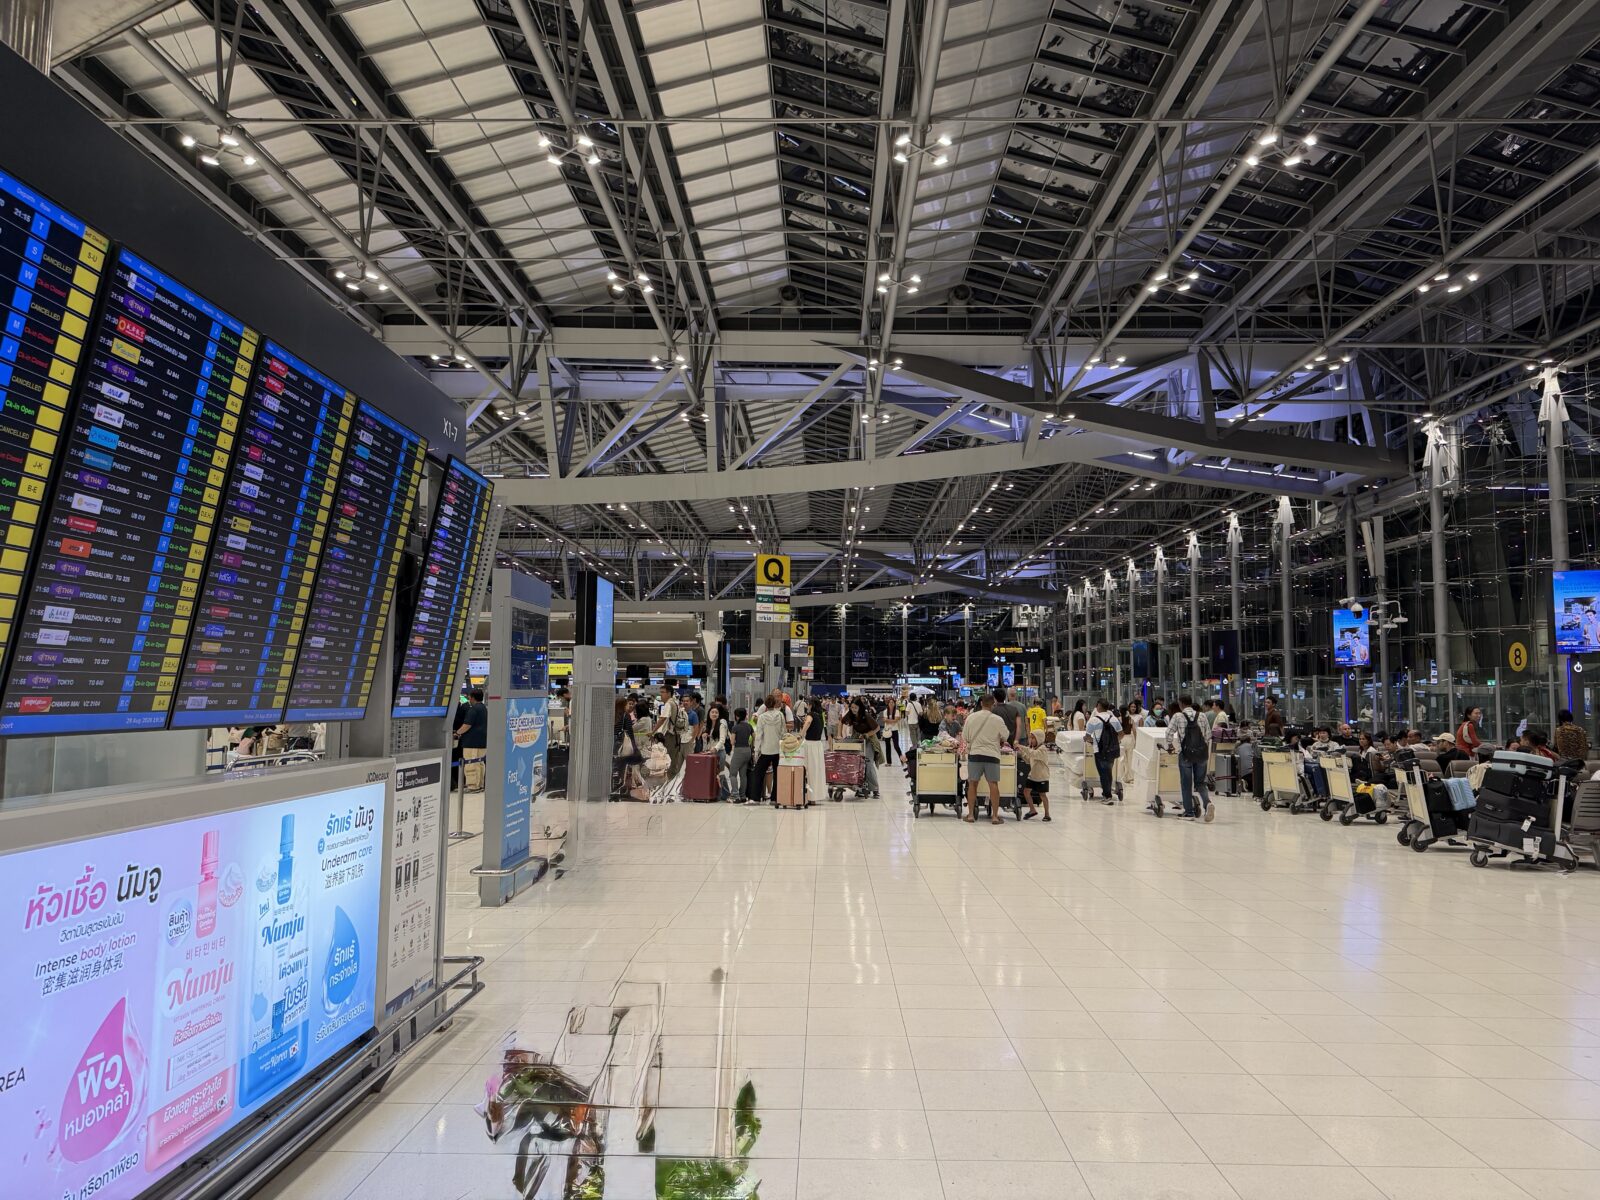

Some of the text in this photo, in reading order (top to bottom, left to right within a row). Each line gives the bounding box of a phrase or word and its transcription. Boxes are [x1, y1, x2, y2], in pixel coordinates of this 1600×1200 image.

[32, 247, 72, 274] S CANCELLED
[25, 270, 33, 280] W
[154, 292, 178, 311] SINGAPORE
[31, 302, 60, 320] CANCELLED
[139, 355, 154, 367] CLARK
[12, 376, 42, 392] CANCELLED
[5, 399, 35, 416] Ck-in Open
[128, 397, 144, 409] TOKYO
[123, 419, 139, 430] TOKYO
[111, 462, 130, 473] PHUKET
[2, 478, 16, 488] Open
[763, 558, 784, 584] Q
[73, 613, 104, 622] GUANGZHOU
[795, 624, 805, 637] S
[1513, 647, 1522, 666] 8
[1032, 713, 1037, 723] 9
[508, 770, 518, 784] Fast
[322, 846, 372, 871] Underarm care
[25, 865, 107, 930] หัวเชื้อ
[262, 913, 304, 947] Numju
[35, 934, 136, 977] Intense body lotion
[168, 958, 234, 1010] Numju
[78, 1052, 123, 1105] ผิว
[64, 1084, 129, 1140] หมองคล้ำ
